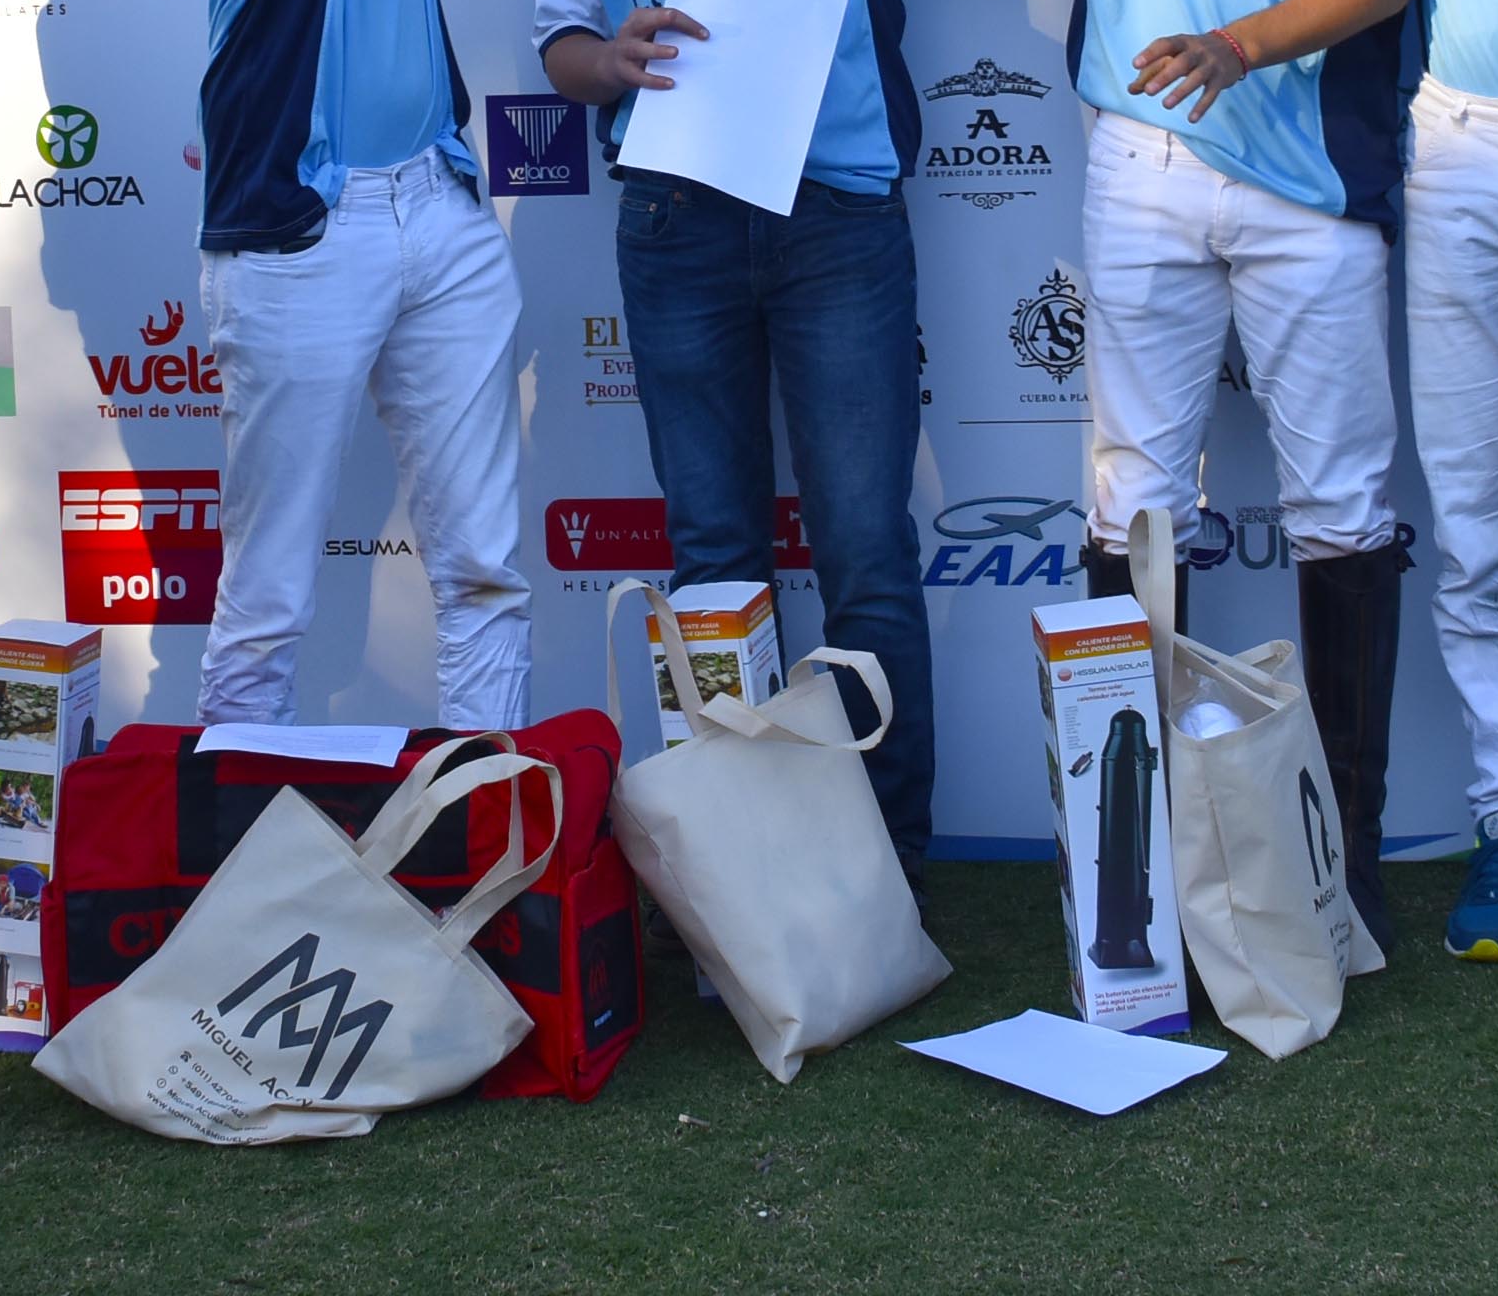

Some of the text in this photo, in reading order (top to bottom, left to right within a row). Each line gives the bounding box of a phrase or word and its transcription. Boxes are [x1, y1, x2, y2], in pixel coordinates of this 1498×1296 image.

[926, 144, 1052, 167] ADORA
[926, 168, 983, 178] ESTACIÓN
[1006, 167, 1053, 176] CARNES
[582, 316, 621, 347] El
[1019, 392, 1089, 403] CUERO & PLA
[98, 403, 222, 419] Túnel de Vient
[61, 488, 220, 532] ESPN
[595, 530, 661, 541] UN'ALT
[322, 539, 413, 556] SSUMA
[923, 544, 1066, 586] EAA
[103, 567, 187, 608] polo
[1076, 633, 1133, 647] CALIENTE AGUA
[1064, 648, 1080, 656] CON
[1091, 644, 1116, 653] PODER
[191, 1008, 253, 1076] MIGUEL
